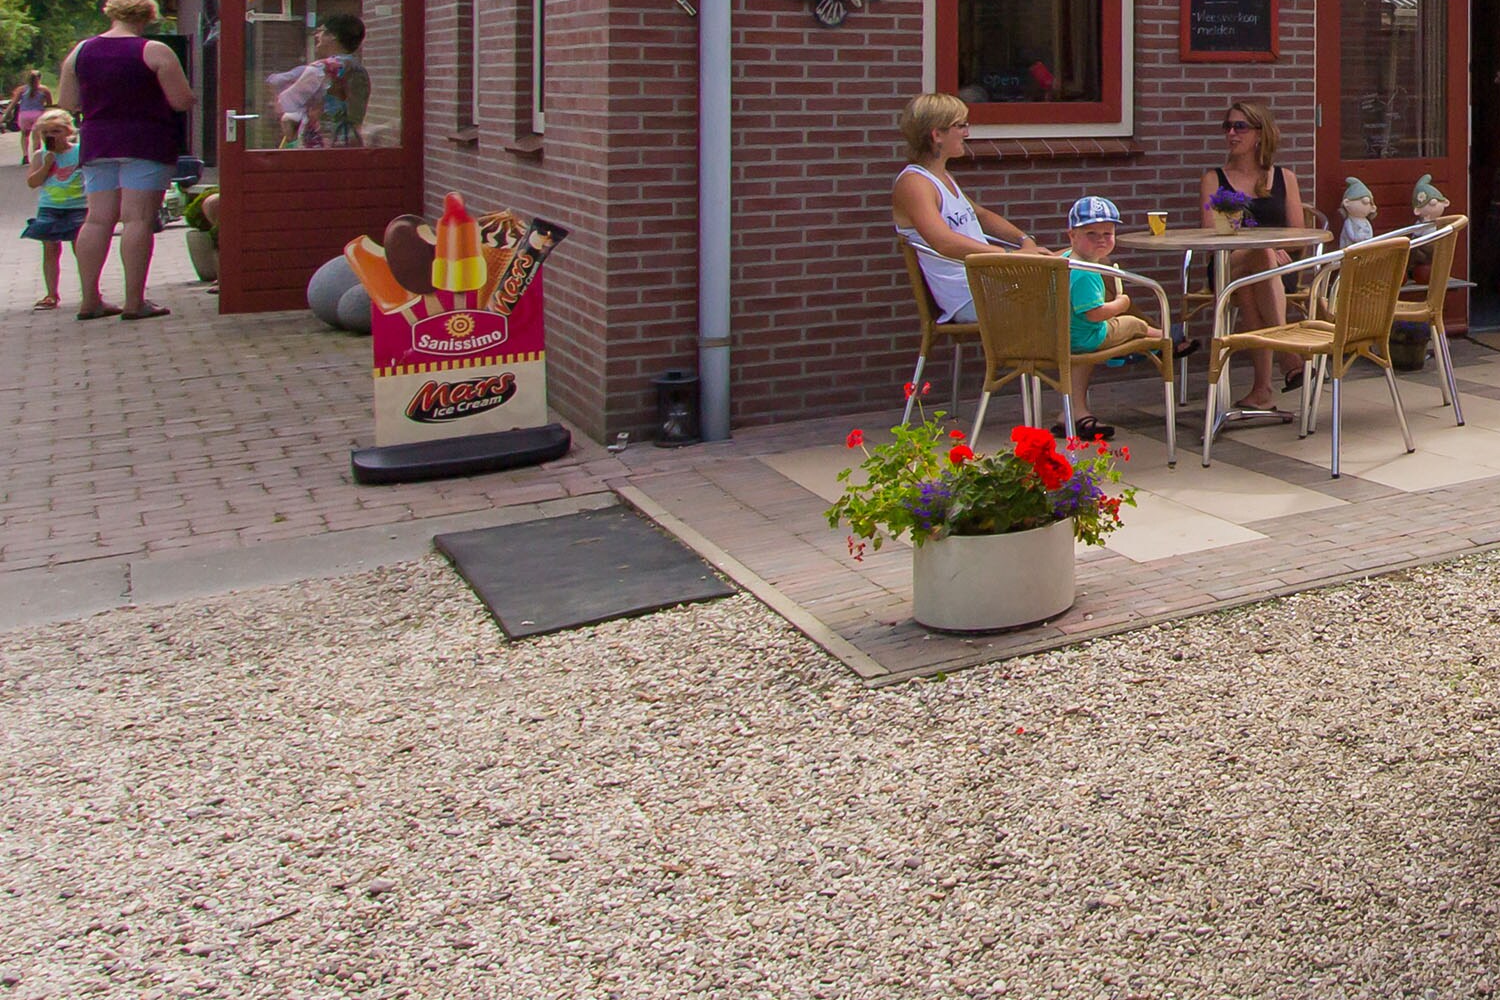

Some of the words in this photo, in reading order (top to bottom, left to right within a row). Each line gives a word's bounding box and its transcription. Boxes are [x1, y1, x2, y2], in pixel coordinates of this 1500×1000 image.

[495, 249, 534, 316] Mars
[418, 330, 503, 351] Sanissimo
[405, 372, 516, 418] Mars
[433, 406, 455, 418] Ice
[456, 395, 503, 412] Cream
